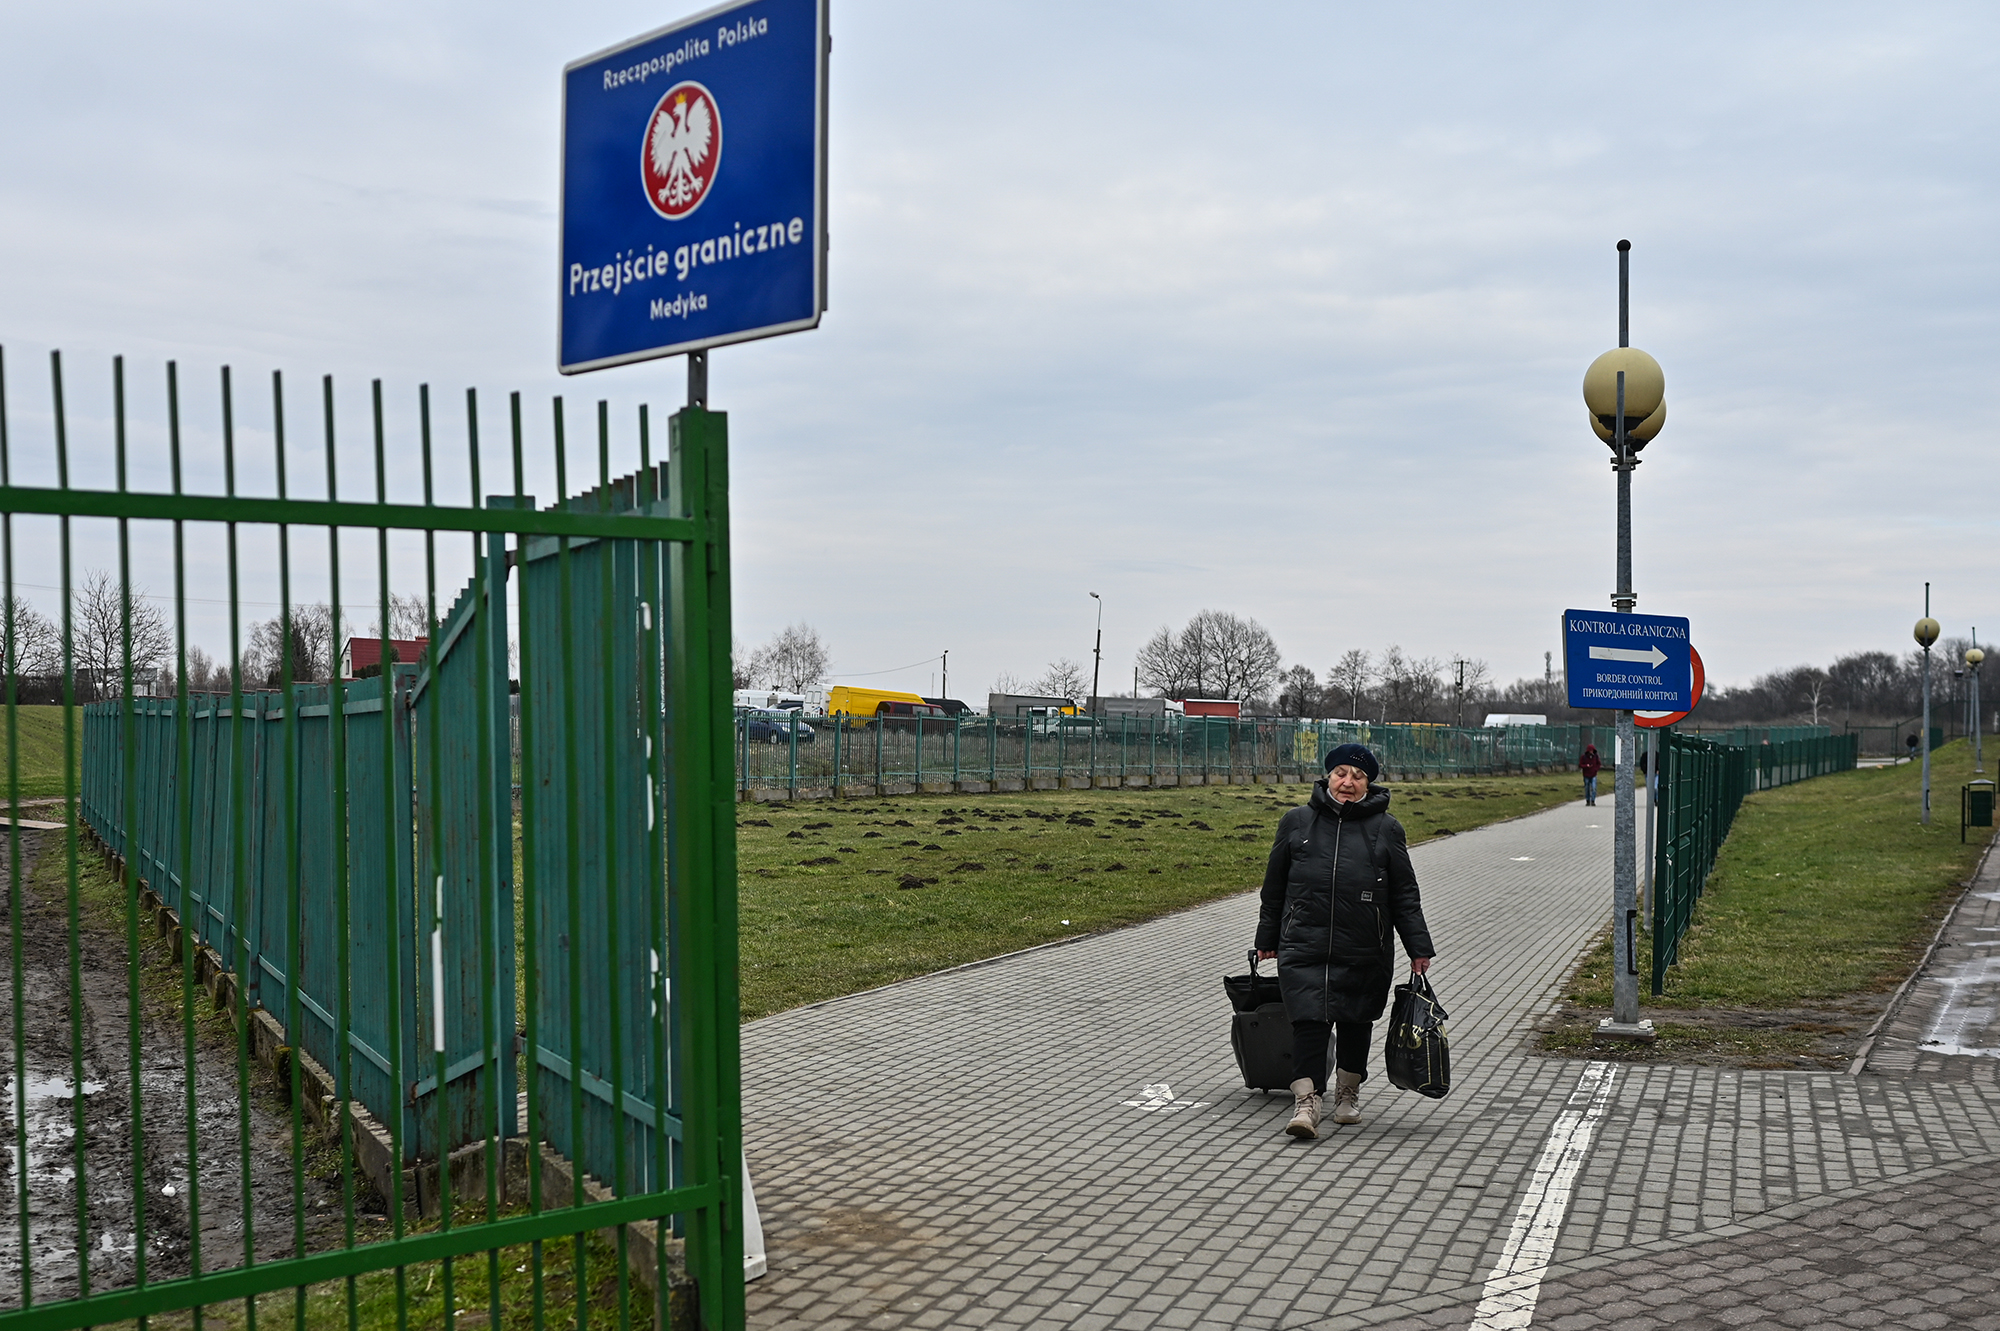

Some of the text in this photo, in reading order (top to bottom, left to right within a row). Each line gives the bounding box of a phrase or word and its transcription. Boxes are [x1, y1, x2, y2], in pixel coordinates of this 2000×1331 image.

[603, 17, 768, 90] Rzeczpospolita Polska
[570, 216, 804, 296] Przejście graniczne
[649, 291, 708, 321] Medyka
[1570, 619, 1686, 639] KONTROLA GRANICZNA
[1596, 673, 1663, 685] BORDER CONTROL
[1582, 687, 1678, 701] ПРИКОРДОННИЙ КОНТРОЛ
